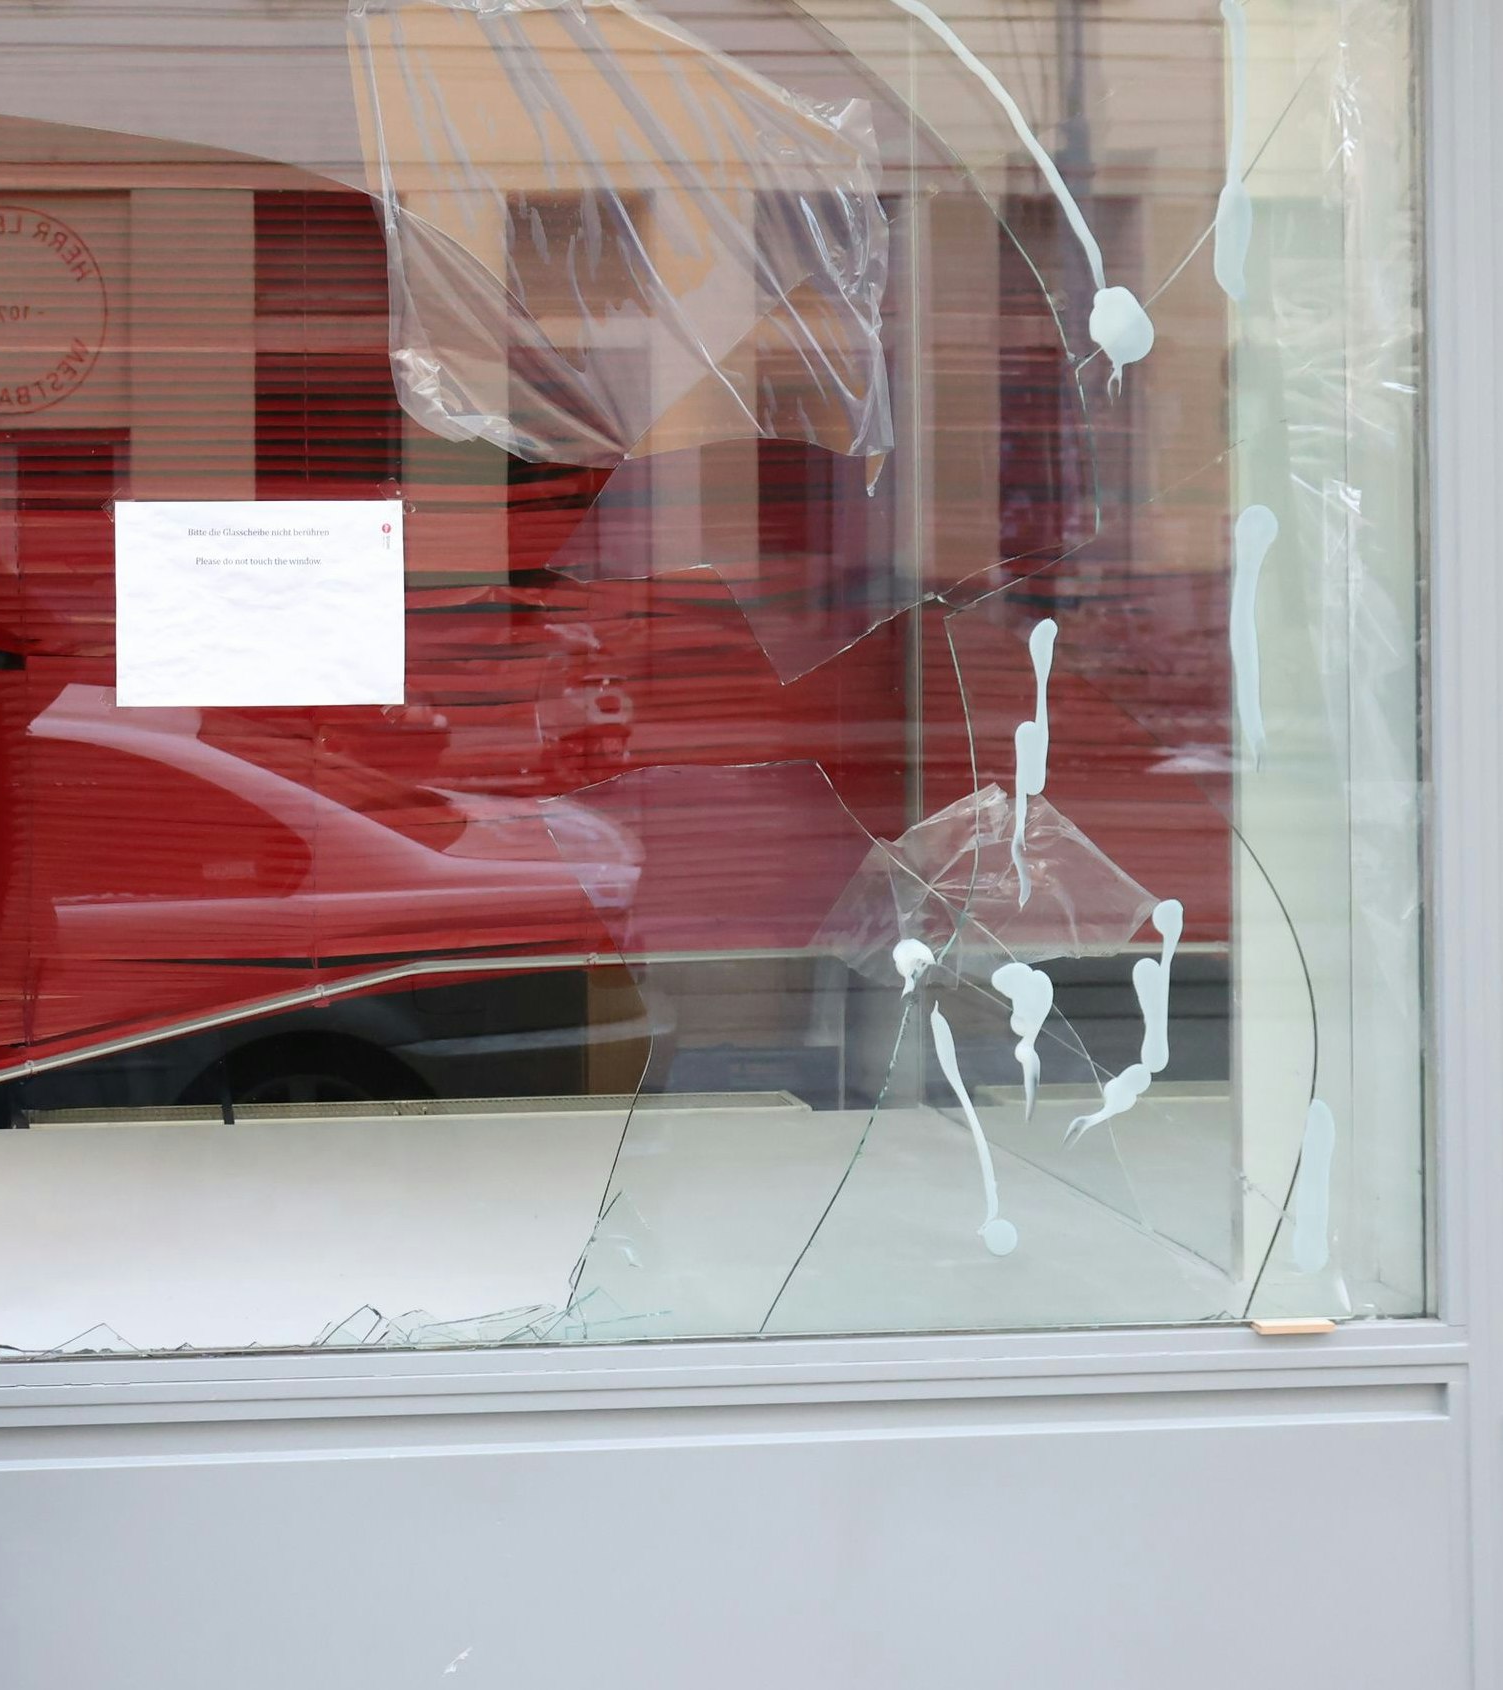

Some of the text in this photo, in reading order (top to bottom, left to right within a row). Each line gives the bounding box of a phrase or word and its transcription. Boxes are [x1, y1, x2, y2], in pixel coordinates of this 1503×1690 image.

[187, 528, 330, 537] Bitte die Glasscheibe nicht berühren
[195, 557, 221, 566] Please
[222, 557, 234, 566] do
[235, 557, 248, 566] not
[250, 557, 273, 566] touch
[274, 557, 288, 566] the
